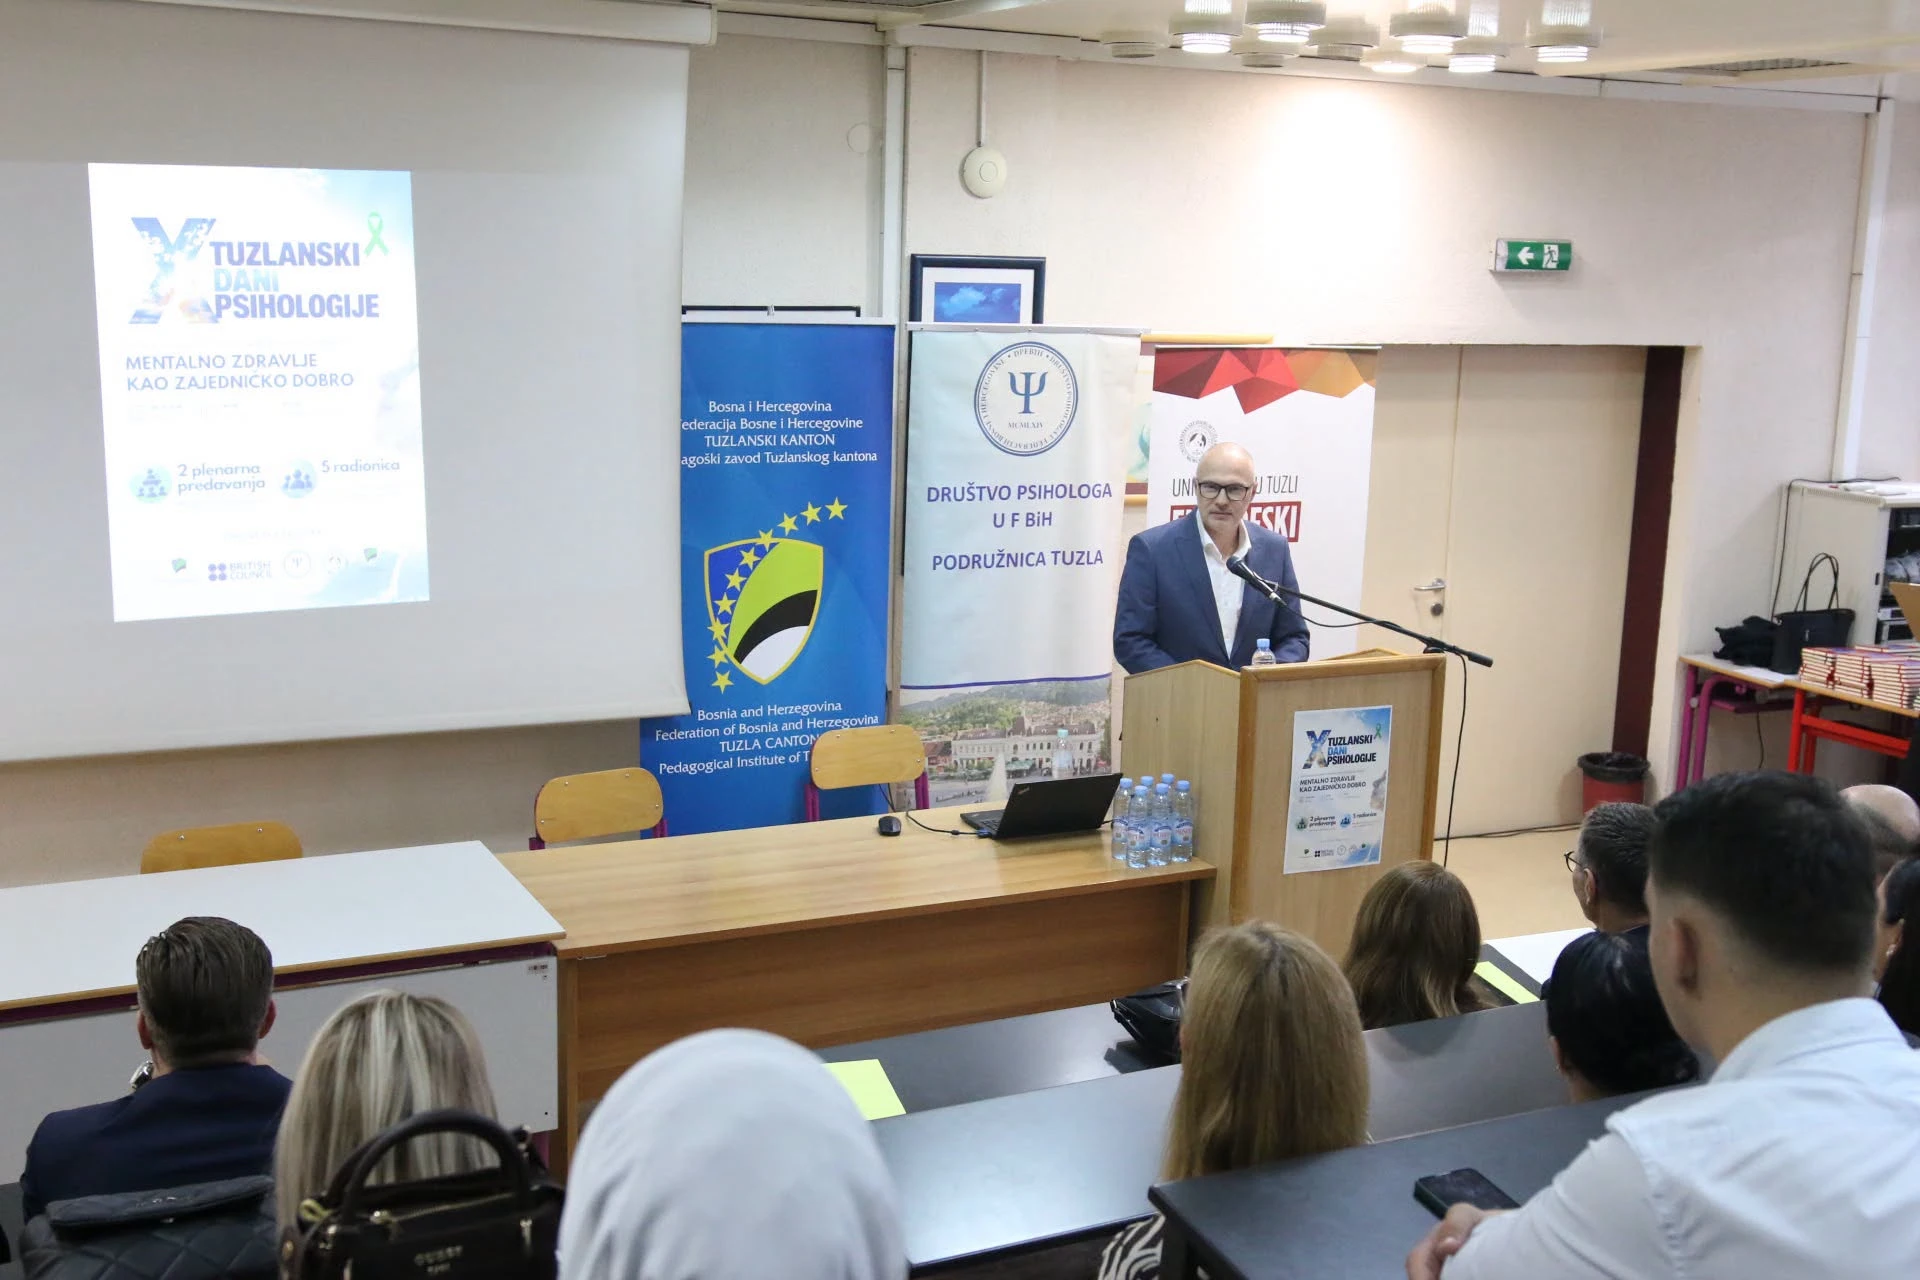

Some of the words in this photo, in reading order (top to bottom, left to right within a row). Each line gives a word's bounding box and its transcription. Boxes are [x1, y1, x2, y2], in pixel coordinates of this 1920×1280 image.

[210, 241, 361, 267] TUZLANSKI
[214, 268, 280, 293] DANI
[215, 293, 380, 319] PSIHOLOGIJE
[126, 354, 226, 371] MENTALNO
[231, 353, 319, 369] ZDRAVLJE
[127, 376, 169, 392] KAO
[175, 369, 288, 390] ZAJEDNIČKO
[292, 373, 355, 388] DOBRO
[709, 401, 745, 413] Bosna
[749, 401, 753, 413] i
[756, 400, 832, 415] Hercegovina
[680, 418, 737, 433] ederacija
[740, 417, 777, 430] Bosne
[780, 417, 784, 429] i
[787, 417, 864, 432] Hercegovine
[704, 435, 777, 448] TUZLANSKI
[780, 433, 836, 447] KANTON
[321, 460, 330, 473] 5
[333, 458, 401, 473] radionica
[681, 453, 721, 469] agoški
[724, 452, 761, 465] zavod
[764, 451, 830, 467] Tuzlanskog
[833, 450, 878, 463] kantona
[178, 463, 188, 477] 2
[191, 463, 261, 479] plenarna
[177, 477, 266, 496] predavanja
[927, 482, 1011, 503] DRUŠTVO
[1017, 482, 1113, 501] PSIHOLOGA
[1267, 475, 1299, 494] TUZLI
[993, 513, 1006, 528] U
[1011, 513, 1020, 528] F
[1025, 512, 1053, 527] BiH
[932, 549, 1047, 571] PODRUŽNICA
[1051, 550, 1104, 566] TUZLA
[697, 709, 737, 722] Bosnia
[740, 705, 764, 719] and
[767, 701, 842, 717] Herzegovina
[655, 728, 720, 742] Federation
[723, 723, 736, 735] of
[739, 722, 779, 734] Bosnia
[781, 719, 803, 731] and
[807, 714, 879, 730] Herzegovina
[719, 738, 762, 753] TUZLA
[765, 734, 819, 749] CANTON
[1327, 746, 1348, 755] DANI
[1328, 735, 1373, 747] TUZLANSKI
[659, 757, 733, 775] Pedagogical
[737, 754, 786, 768] Institute
[788, 750, 801, 763] of
[1327, 753, 1376, 765] PSIHOLOGIJE
[1300, 777, 1329, 785] MENTALNO
